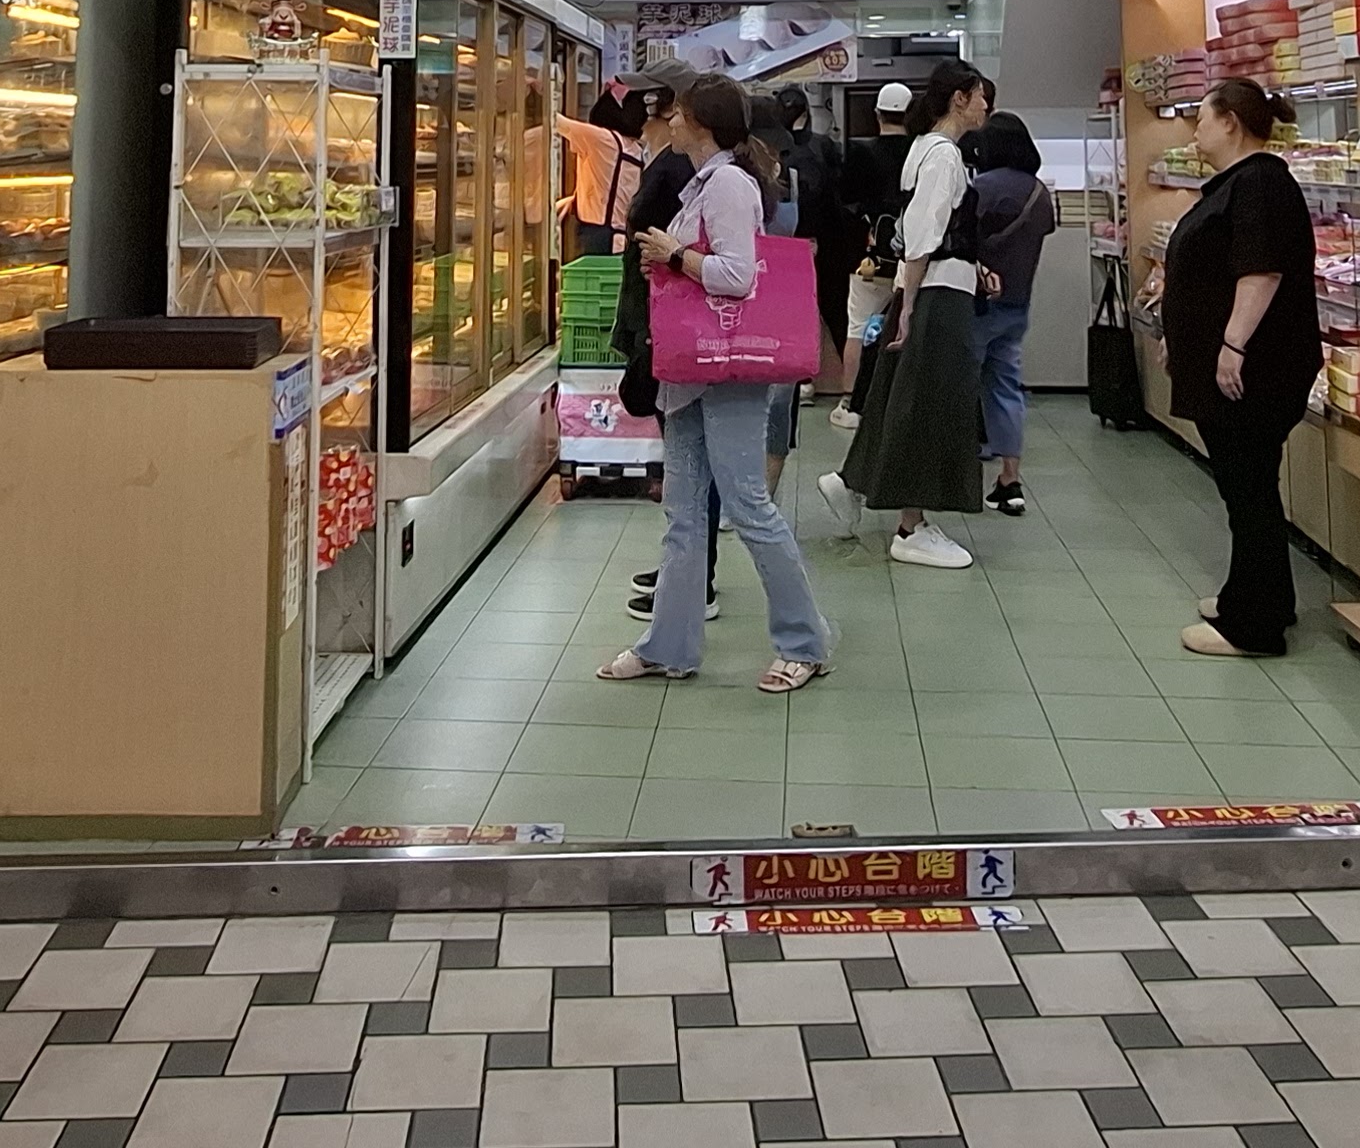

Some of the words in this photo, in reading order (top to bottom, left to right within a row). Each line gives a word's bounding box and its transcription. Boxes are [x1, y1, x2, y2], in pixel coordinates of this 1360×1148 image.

[641, 3, 722, 26] 芋泥球
[755, 850, 956, 884] 小心台階
[753, 887, 791, 900] WATCH
[794, 886, 825, 899] YOUR
[827, 885, 862, 898] STEPS
[758, 908, 963, 925] 小心台階
[800, 924, 835, 932] YOUR
